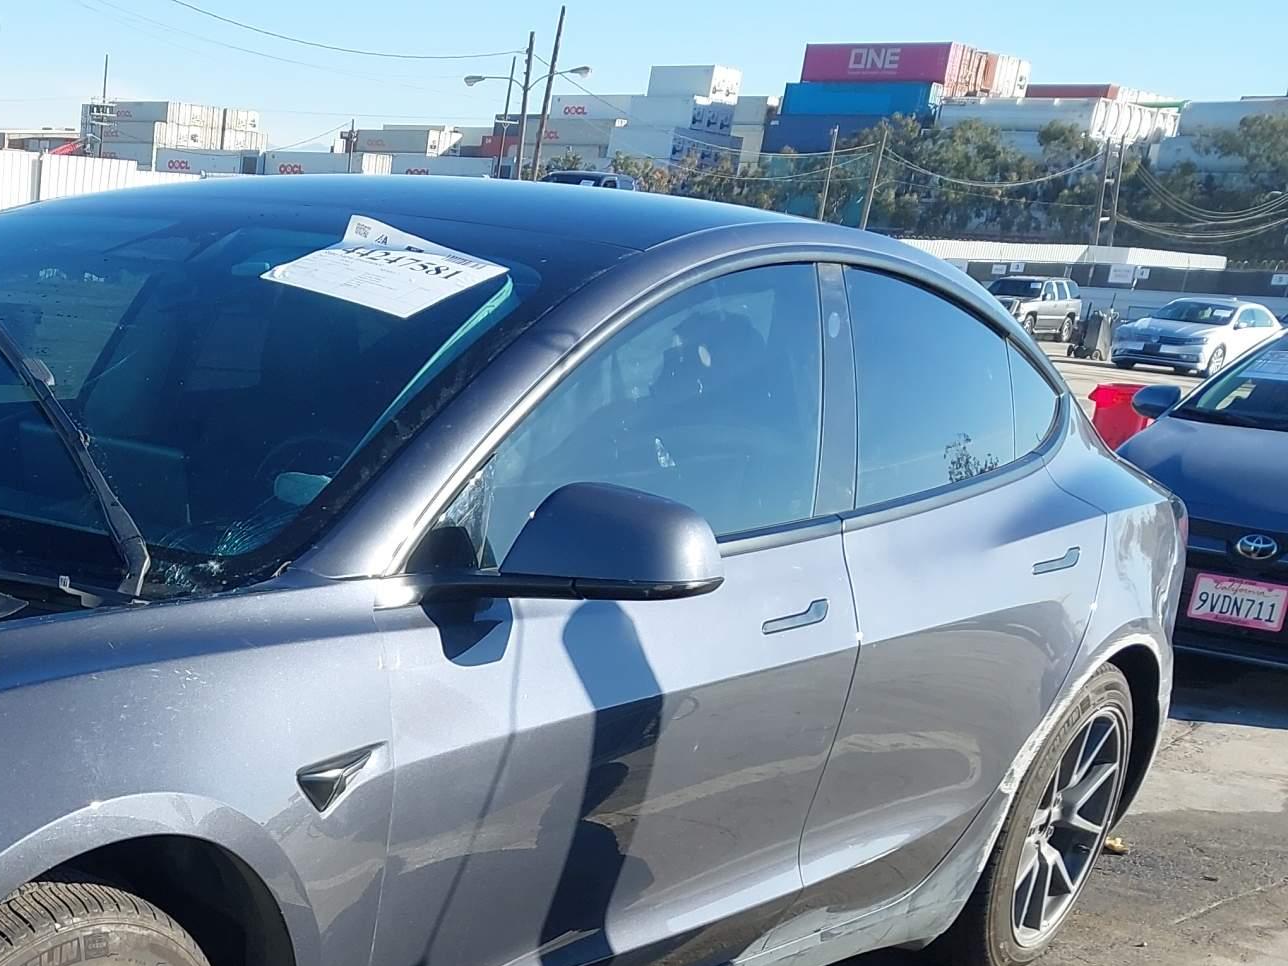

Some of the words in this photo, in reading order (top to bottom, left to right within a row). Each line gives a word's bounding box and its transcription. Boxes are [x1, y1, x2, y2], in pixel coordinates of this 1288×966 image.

[848, 47, 902, 69] ONE
[563, 105, 588, 115] OOCL
[167, 159, 191, 170] OOCL
[278, 163, 304, 175] OOCL
[342, 246, 463, 280] 44247581
[1194, 591, 1277, 623] 9VDN711
